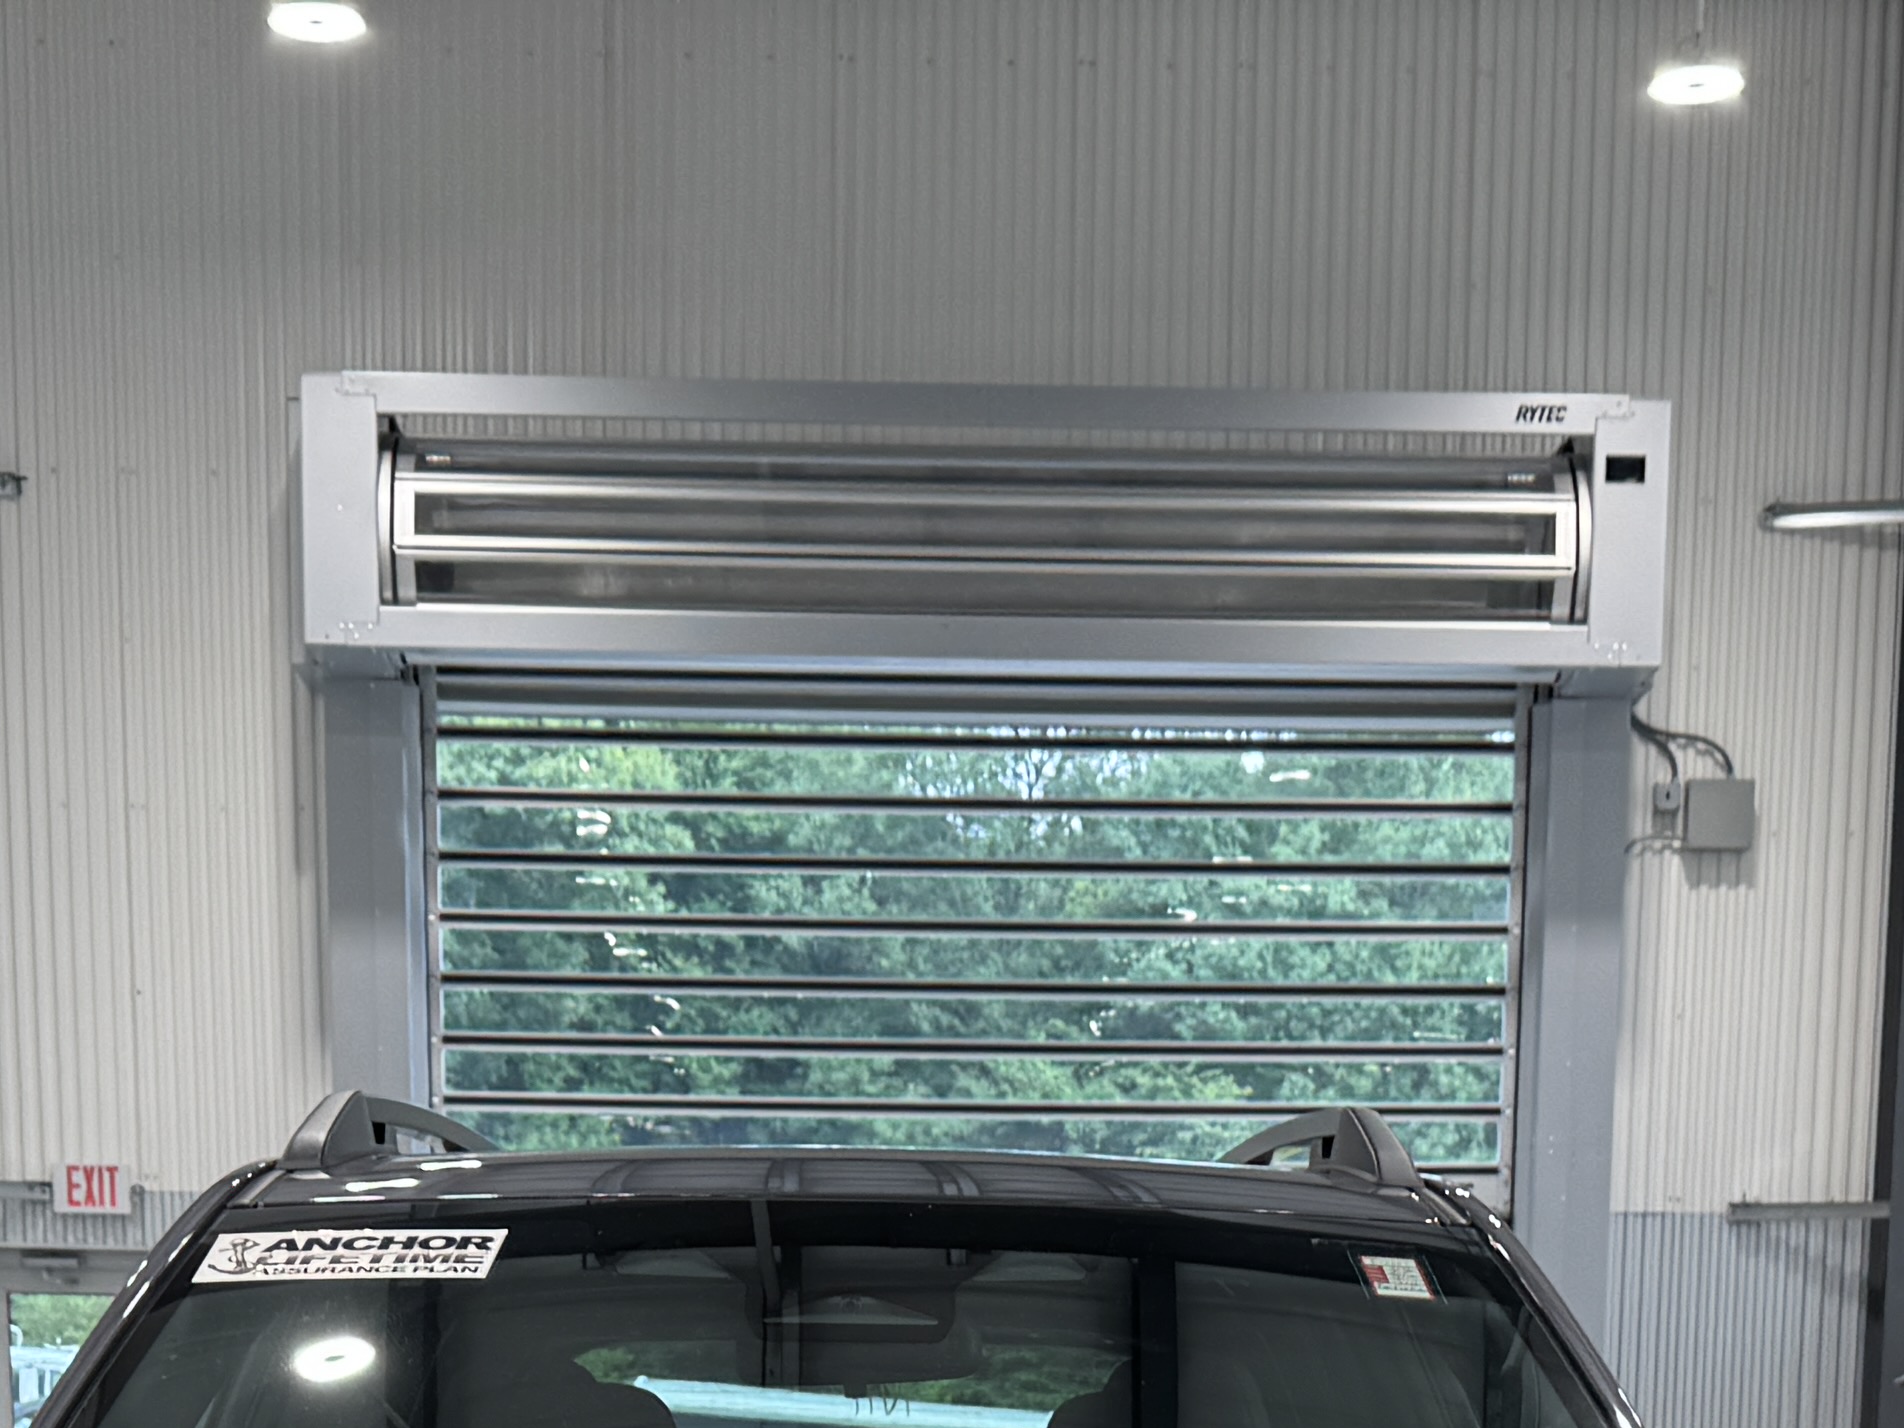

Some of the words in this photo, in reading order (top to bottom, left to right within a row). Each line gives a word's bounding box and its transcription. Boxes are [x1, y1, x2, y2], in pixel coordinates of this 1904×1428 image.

[1514, 404, 1568, 423] RYTEC
[66, 1165, 119, 1209] EXIT
[261, 1235, 495, 1252] ANCHOR
[255, 1253, 485, 1265] LIFETIME
[412, 1265, 480, 1274] PLAN
